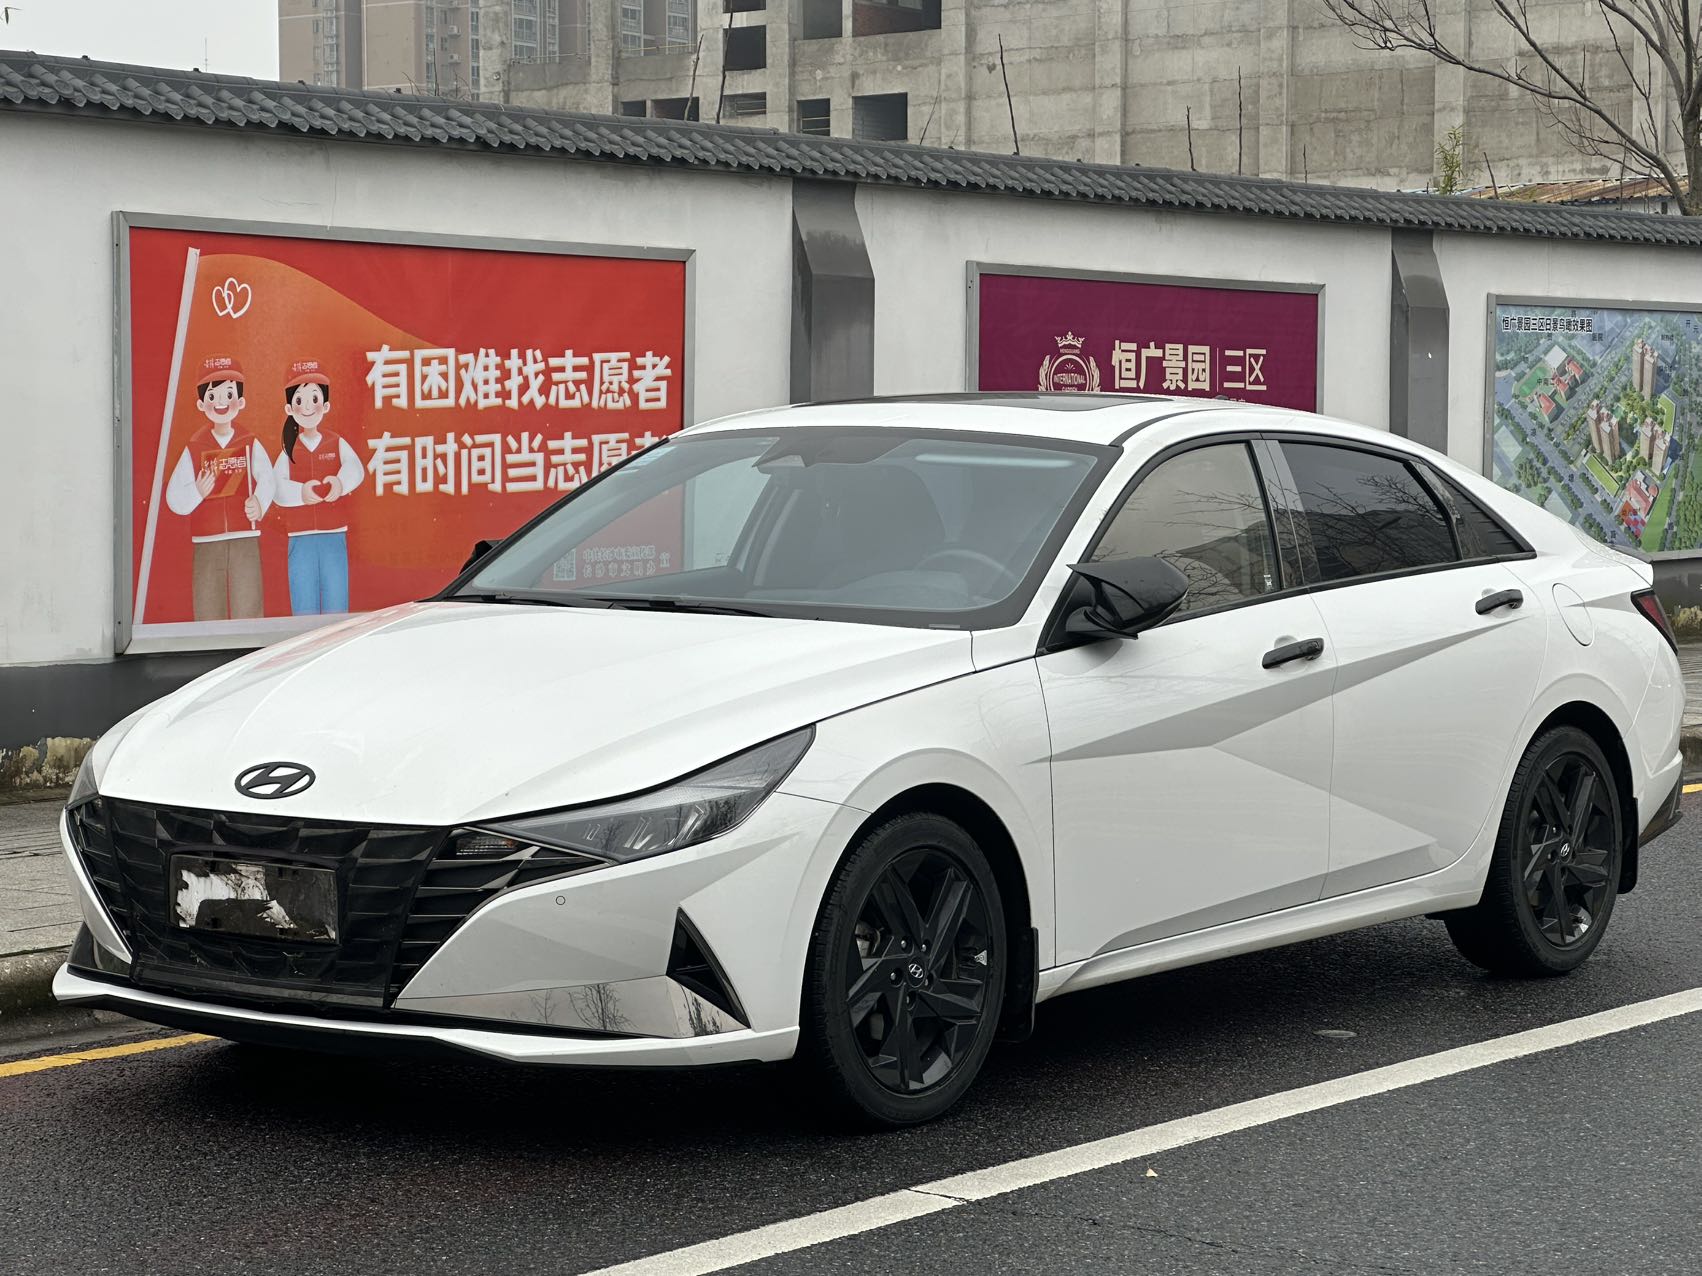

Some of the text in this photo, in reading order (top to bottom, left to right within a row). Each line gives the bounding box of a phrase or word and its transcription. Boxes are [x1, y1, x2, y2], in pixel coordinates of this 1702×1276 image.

[1502, 317, 1593, 333] 恒广景园三区日景鸟瞰效果图
[365, 344, 672, 410] 有困难找志愿者
[1111, 340, 1267, 391] 恒广景园 三区
[367, 431, 668, 496] 有时间当志愿
